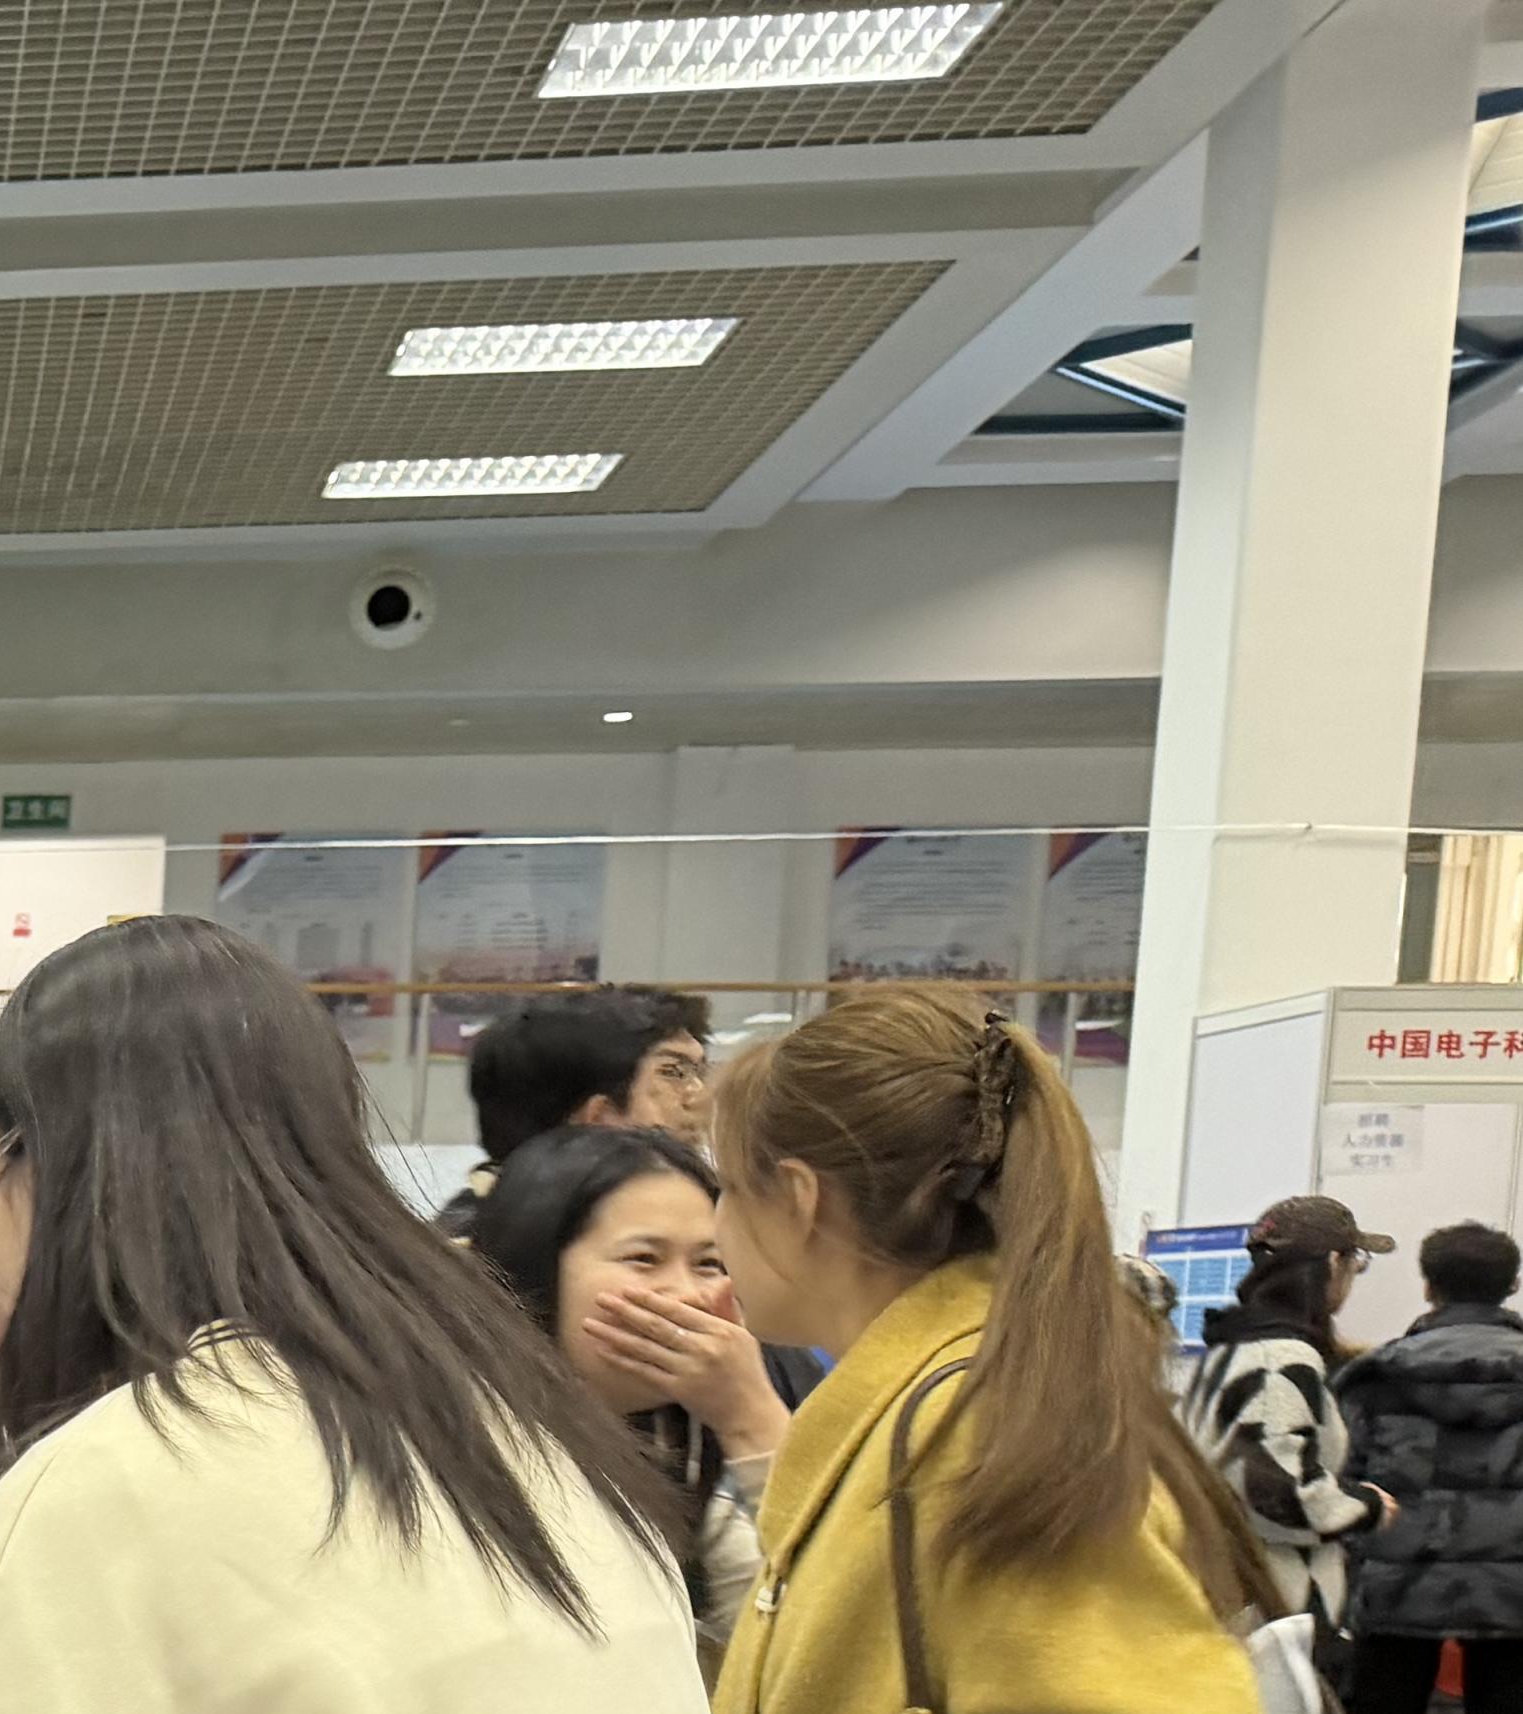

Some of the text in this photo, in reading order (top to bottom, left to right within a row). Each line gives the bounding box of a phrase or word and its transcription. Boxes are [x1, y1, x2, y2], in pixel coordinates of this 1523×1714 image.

[1367, 1029, 1523, 1059] 中国电子科
